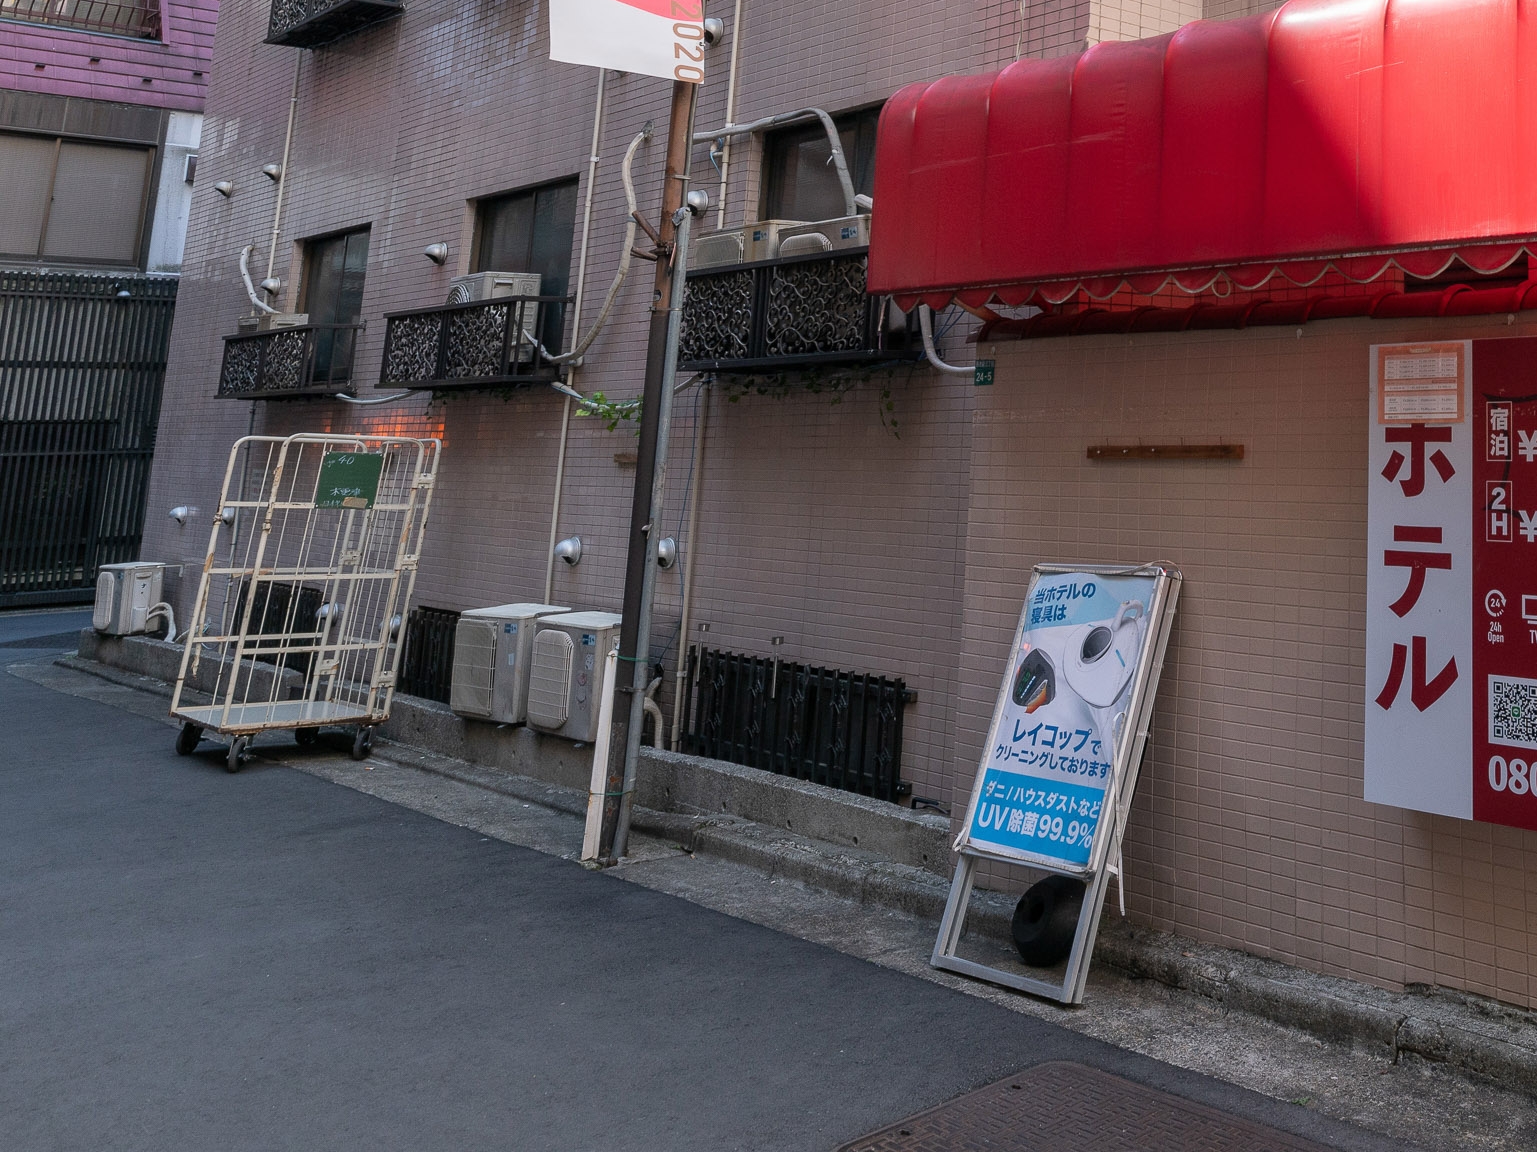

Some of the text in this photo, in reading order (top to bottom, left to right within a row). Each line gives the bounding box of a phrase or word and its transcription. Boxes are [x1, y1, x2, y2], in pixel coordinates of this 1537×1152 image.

[671, 0, 705, 84] 2020
[975, 372, 992, 382] 24-5
[1489, 407, 1509, 457] 宿泊
[1375, 423, 1459, 712] ホテル
[1033, 582, 1096, 605] 当ホテルの
[1031, 604, 1067, 624] 寝具は
[1489, 621, 1502, 633] 24h
[1487, 631, 1505, 645] Open
[1012, 719, 1102, 756] レイコップで
[995, 744, 1111, 779] クリーニングしております
